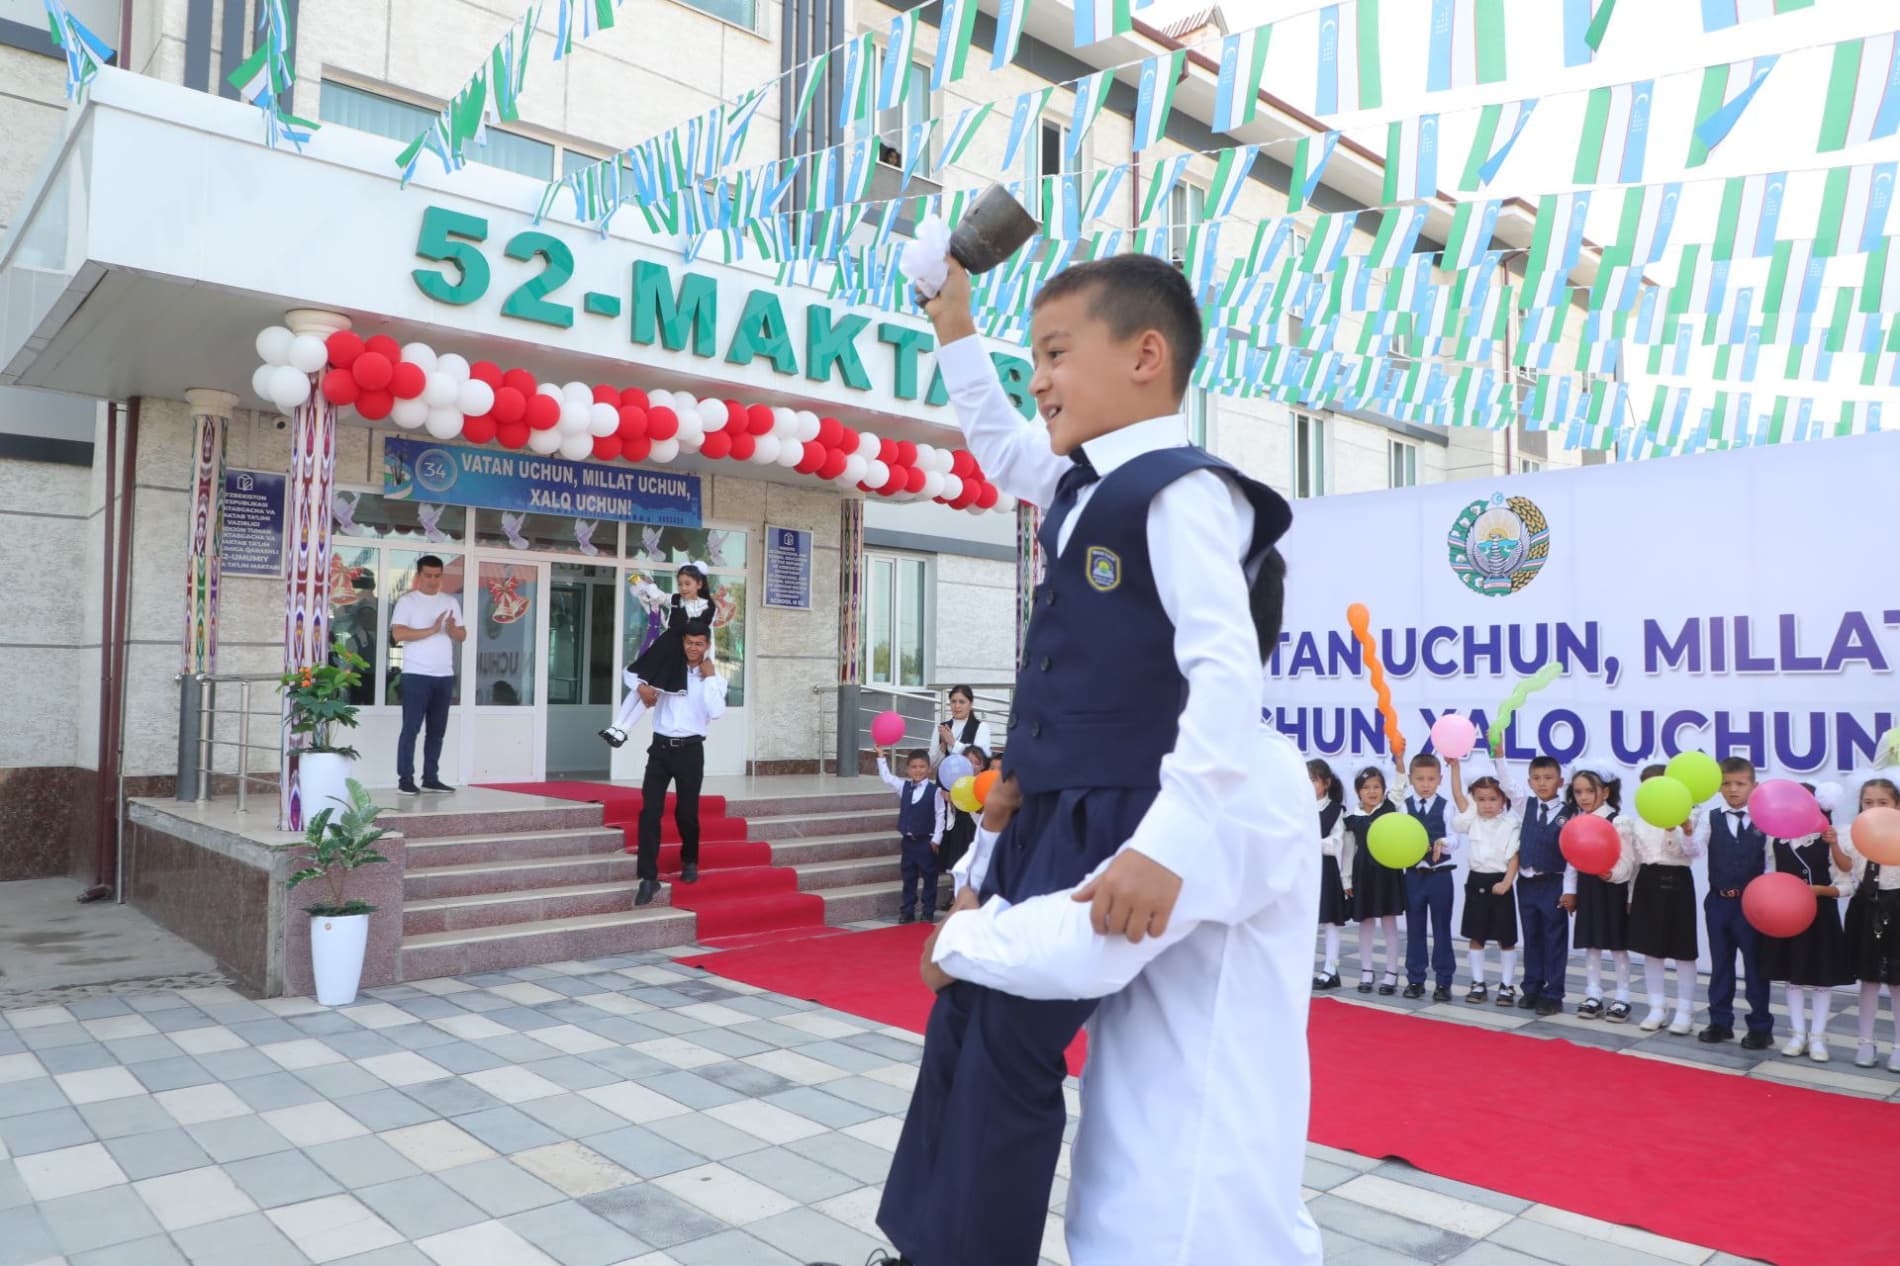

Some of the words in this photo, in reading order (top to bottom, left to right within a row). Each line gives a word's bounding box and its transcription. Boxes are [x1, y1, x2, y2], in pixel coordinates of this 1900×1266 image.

[424, 462, 447, 479] 34
[461, 453, 513, 476] VATAN
[520, 461, 578, 488] UCHUN,
[582, 468, 634, 491] MILLAT
[638, 476, 691, 501] UCHUN,
[530, 488, 571, 510] XALQ
[576, 494, 632, 515] UCHUN!
[1271, 630, 1362, 676] TAN
[1382, 620, 1619, 685] UCHUN,
